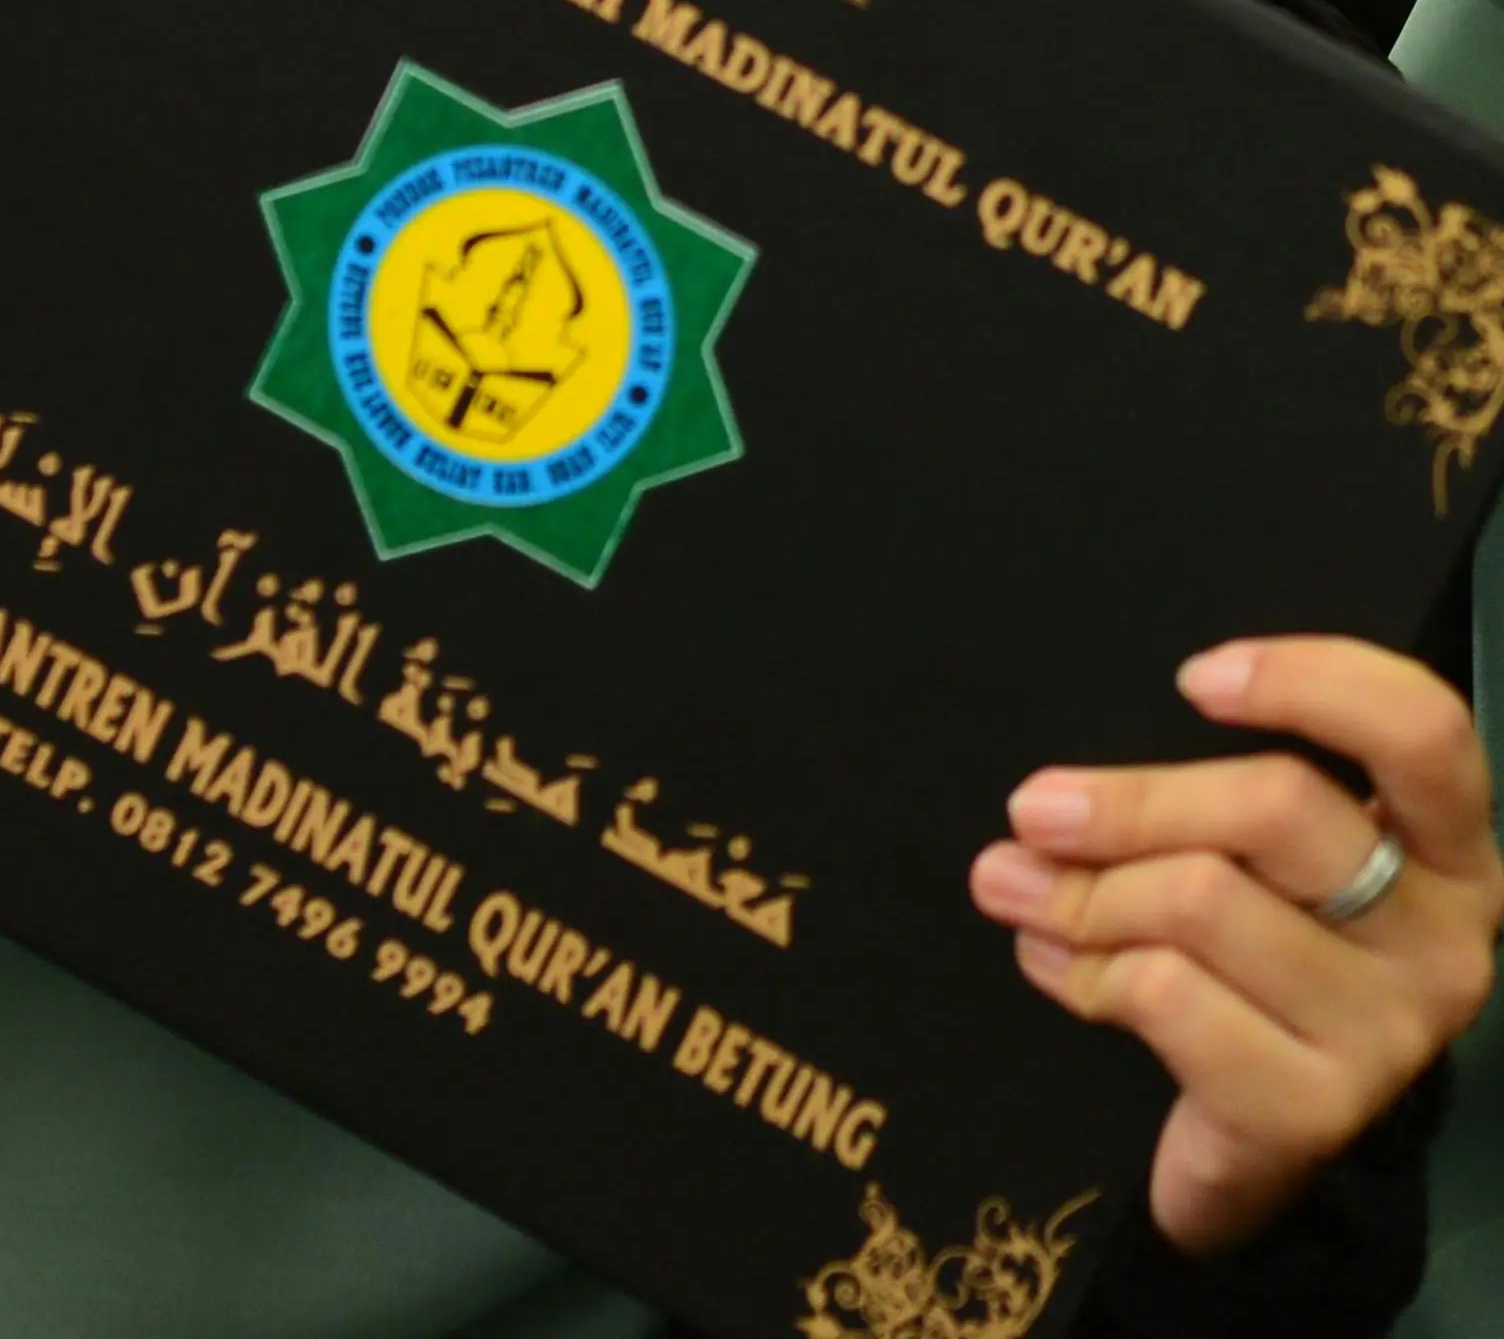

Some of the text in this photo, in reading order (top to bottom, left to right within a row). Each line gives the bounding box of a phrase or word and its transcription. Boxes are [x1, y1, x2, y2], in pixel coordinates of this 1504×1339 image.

[977, 178, 1205, 330] QUR'AN
[110, 792, 232, 886] 0812
[240, 863, 362, 960] 7496
[372, 938, 494, 1035] 9994
[166, 717, 464, 932] MADINATUL
[468, 891, 681, 1052] QUR'AN
[673, 1006, 888, 1170] BETUNG
